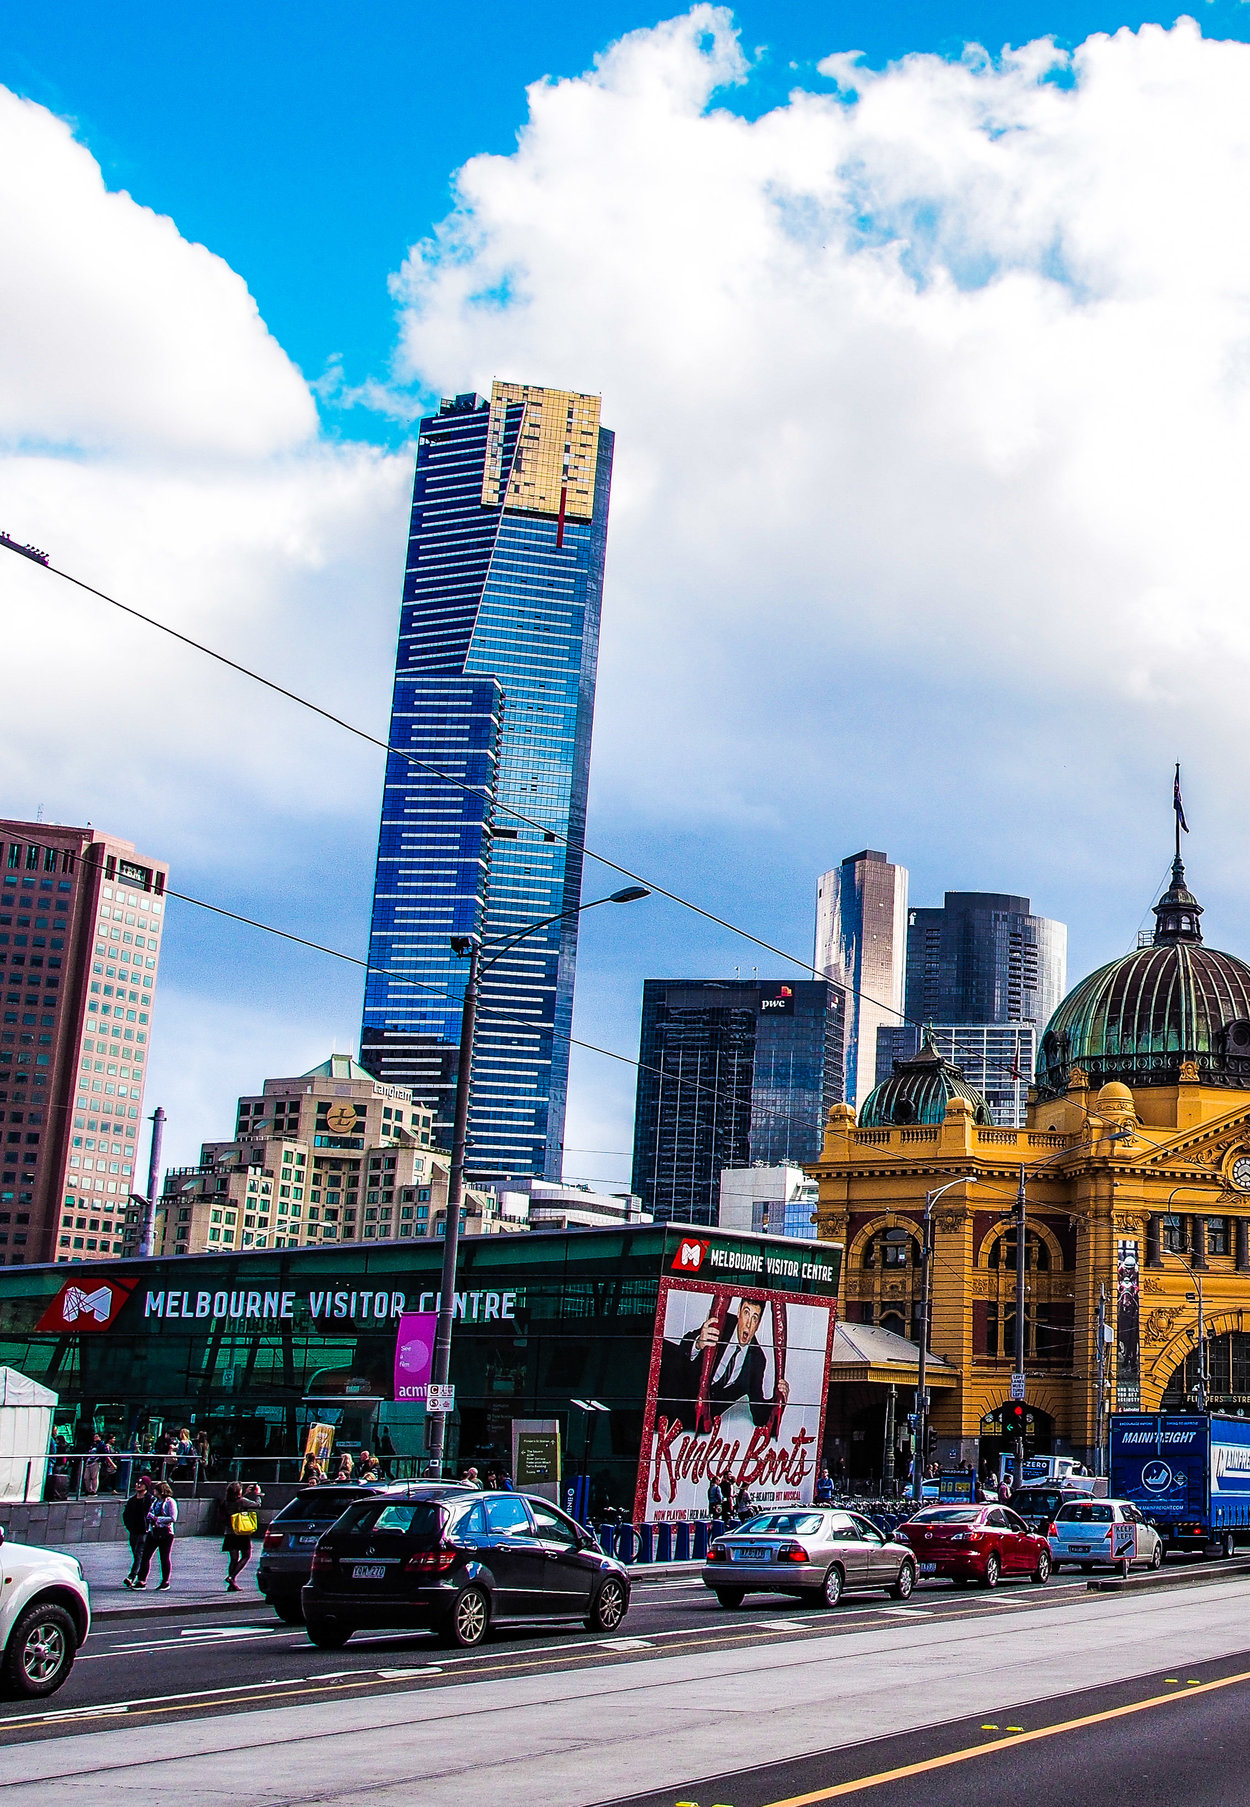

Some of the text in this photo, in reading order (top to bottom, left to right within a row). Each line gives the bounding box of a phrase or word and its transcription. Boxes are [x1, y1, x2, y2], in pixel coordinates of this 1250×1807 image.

[761, 999, 786, 1010] pwc
[373, 1081, 413, 1101] Langham
[711, 1249, 833, 1282] MELBOURNE VISITOR CENTRE
[144, 1291, 517, 1319] MELBOURNE VISITOR CNTRE
[399, 1383, 428, 1397] acmi
[1186, 1395, 1224, 1403] FLIDERS
[1121, 1431, 1197, 1443] MAINFREIGHT
[652, 1415, 817, 1504] Kinky Boots
[666, 1509, 687, 1521] PLAYING
